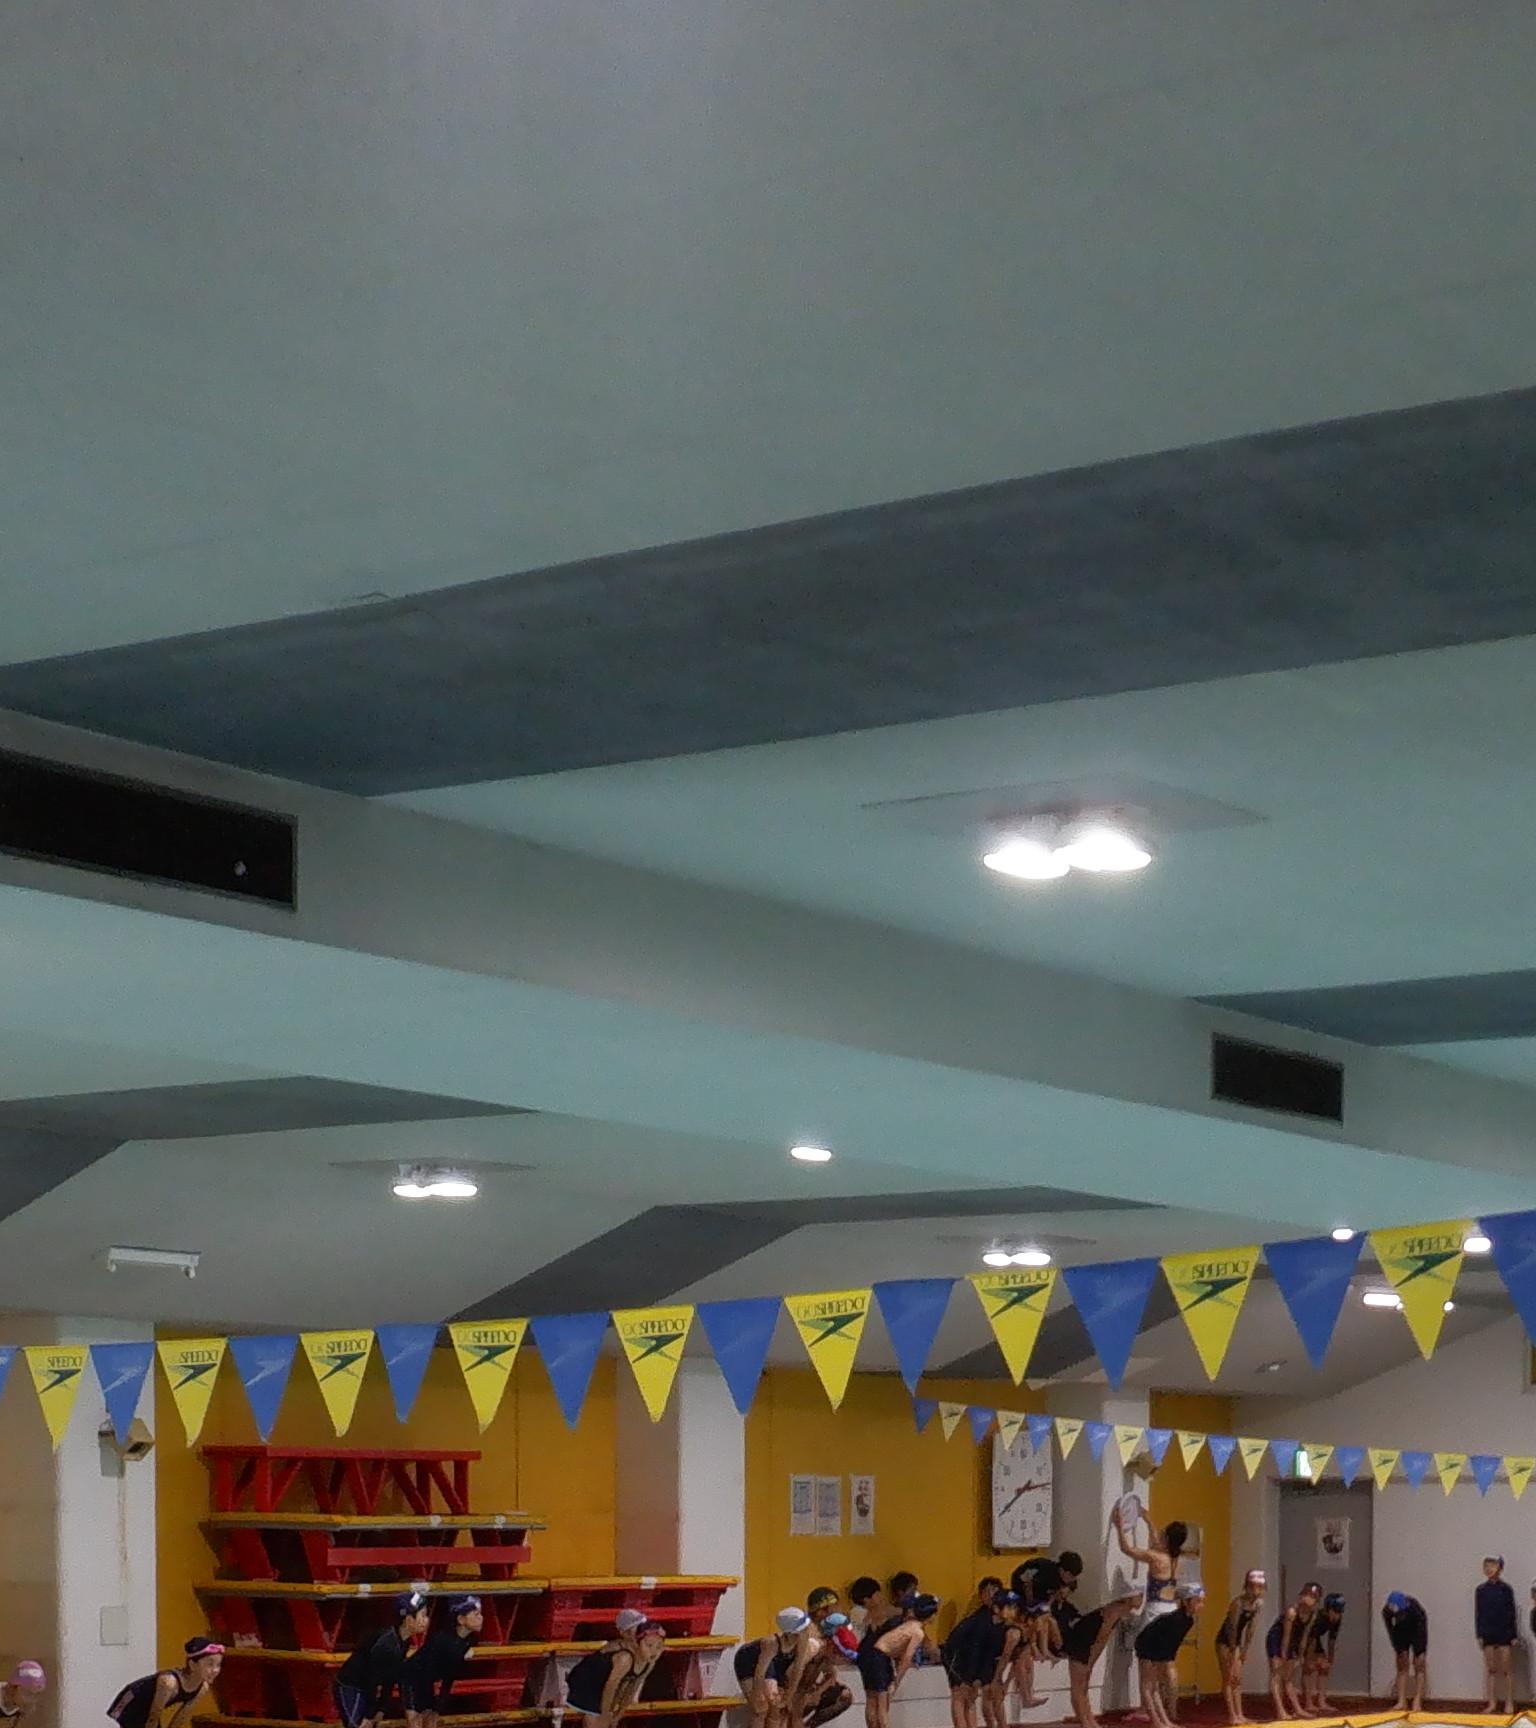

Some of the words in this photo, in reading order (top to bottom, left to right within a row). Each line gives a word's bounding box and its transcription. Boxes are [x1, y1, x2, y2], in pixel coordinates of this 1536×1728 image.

[1407, 1233, 1459, 1256] SPEEDO
[1000, 1268, 1051, 1287] SPEEDO
[1192, 1260, 1249, 1280] SPEEDO
[816, 1297, 864, 1316] SPEEDO
[638, 1319, 684, 1335] SPEEDO
[474, 1330, 517, 1345] SPEEDO
[326, 1340, 367, 1354] SPEEDO
[47, 1356, 82, 1368] SPEEDO
[180, 1350, 218, 1363] SPEEDO
